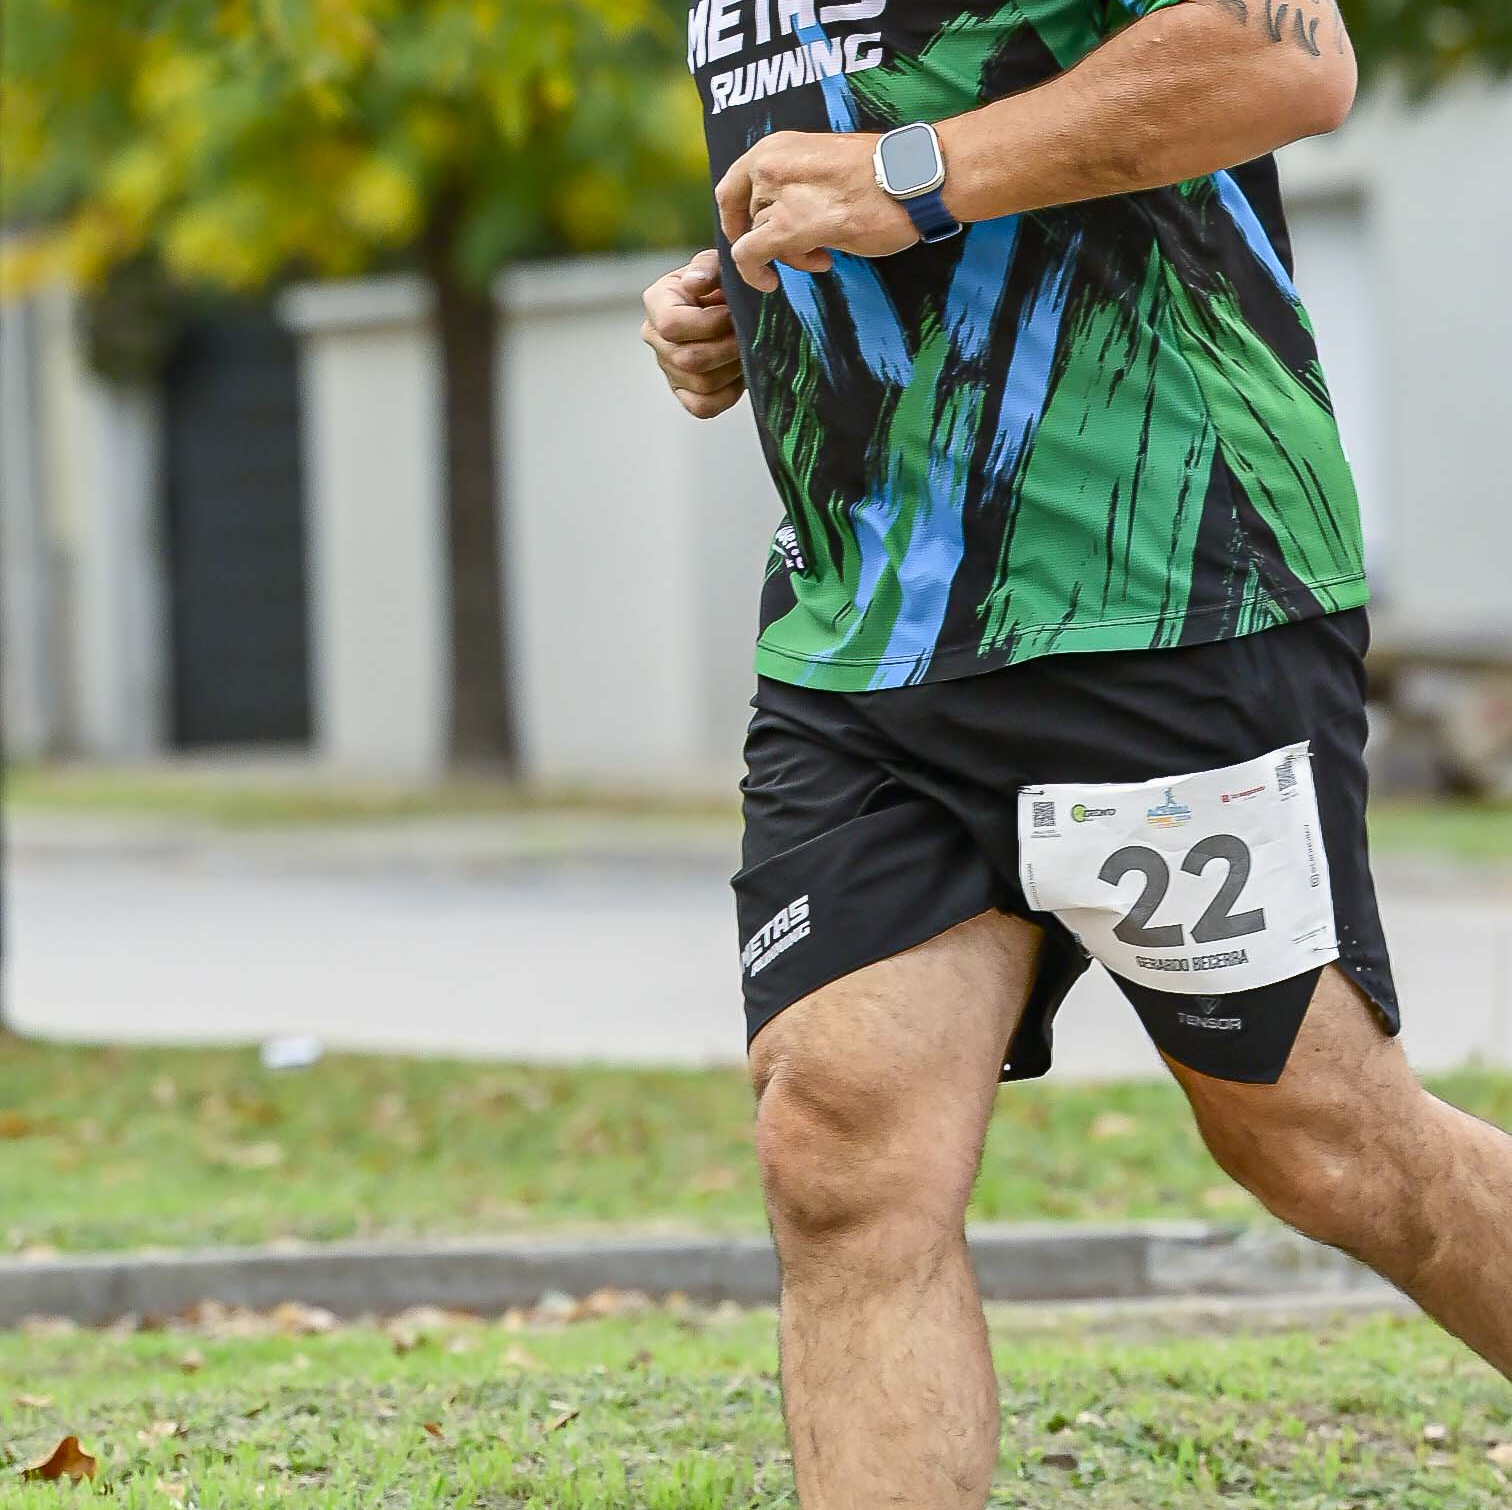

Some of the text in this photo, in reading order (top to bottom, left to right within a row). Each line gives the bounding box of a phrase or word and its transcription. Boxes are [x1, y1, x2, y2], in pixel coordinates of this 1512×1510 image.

[711, 32, 882, 114] RUNNING
[1098, 834, 1266, 947] 22
[741, 894, 810, 972] METAS
